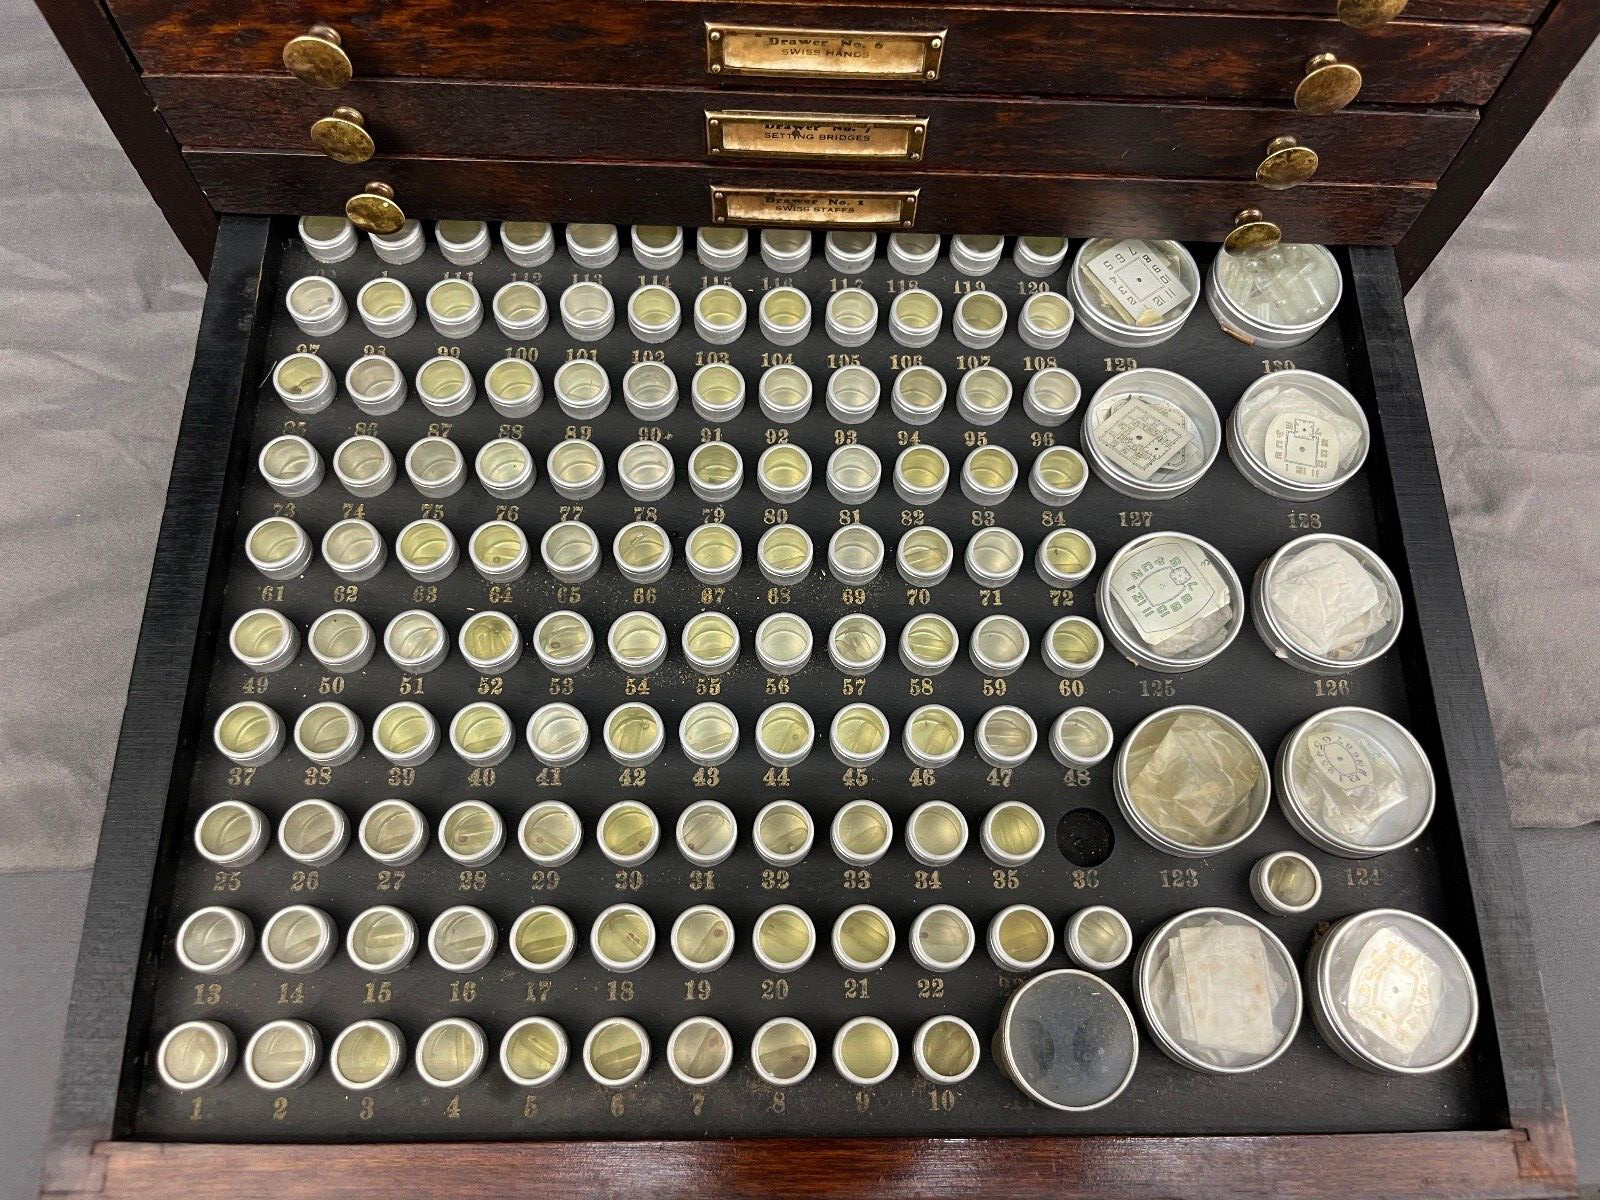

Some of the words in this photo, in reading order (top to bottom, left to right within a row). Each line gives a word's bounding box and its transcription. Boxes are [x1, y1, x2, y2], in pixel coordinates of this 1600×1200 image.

[769, 37, 828, 46] Drawer
[841, 40, 866, 48] No.
[826, 50, 869, 58] HANDS
[765, 197, 821, 205] Drawer
[953, 280, 986, 294] 119
[1018, 282, 1049, 294] 120
[505, 347, 538, 362] 100
[566, 349, 598, 361] 101
[632, 350, 665, 362] 102
[695, 352, 730, 366] 103
[761, 353, 795, 367] 104
[827, 354, 861, 368] 105
[890, 355, 923, 369] 106
[957, 356, 990, 370] 107
[1023, 357, 1057, 370] 108
[1104, 358, 1137, 372] 129
[428, 423, 452, 438] 87
[565, 426, 592, 440] 89
[638, 427, 661, 442] 90
[701, 428, 722, 443] 91
[765, 429, 789, 444] 92
[835, 430, 857, 445] 93
[897, 431, 921, 446] 94
[964, 432, 987, 447] 95
[1031, 432, 1055, 447] 96
[274, 503, 296, 517] 73
[342, 504, 365, 519] 74
[421, 505, 444, 520] 75
[496, 506, 519, 522] 76
[560, 506, 583, 522] 77
[634, 507, 657, 522] 78
[703, 508, 725, 524] 79
[763, 509, 788, 524] 80
[839, 509, 861, 525] 81
[901, 510, 924, 525] 82
[971, 511, 995, 526] 83
[1042, 511, 1065, 527] 84
[1118, 512, 1152, 526] 127
[262, 586, 285, 602] 61
[334, 586, 357, 602] 62
[633, 587, 656, 603] 66
[842, 589, 865, 604] 69
[907, 589, 931, 604] 70
[980, 590, 1003, 605] 71
[1050, 591, 1073, 606] 72
[242, 677, 269, 694] 49
[318, 677, 344, 695] 50
[400, 678, 425, 695] 51
[478, 678, 503, 695] 52
[550, 679, 574, 695] 53
[625, 679, 650, 695] 54
[696, 679, 721, 695] 55
[766, 679, 789, 695] 56
[842, 679, 866, 695] 57
[910, 679, 934, 695] 58
[982, 679, 1007, 696] 59
[1059, 680, 1084, 696] 60
[1140, 680, 1176, 697] 125
[228, 768, 255, 786] 37
[305, 768, 332, 786] 38
[388, 768, 415, 786] 39
[468, 768, 496, 786] 40
[535, 768, 561, 786] 41
[619, 768, 646, 786] 42
[693, 769, 719, 786] 43
[763, 769, 790, 786] 44
[842, 769, 868, 786] 45
[909, 769, 936, 786] 46
[987, 769, 1013, 787] 47
[1063, 769, 1090, 787] 48
[214, 872, 241, 891] 25
[292, 871, 318, 890] 26
[378, 871, 404, 890] 27
[532, 871, 560, 890] 29
[690, 871, 715, 889] 31
[762, 870, 791, 889] 32
[844, 871, 872, 889] 33
[915, 871, 942, 889] 34
[993, 870, 1020, 889] 35
[1161, 870, 1199, 888] 123
[194, 984, 222, 1004] 13
[277, 983, 304, 1003] 14
[364, 982, 392, 1003] 15
[449, 981, 476, 1001] 16
[525, 981, 552, 1001] 17
[607, 981, 634, 1000] 18
[685, 980, 711, 1000] 19
[761, 979, 789, 999] 20
[845, 979, 870, 998] 21
[918, 979, 944, 998] 22
[191, 1098, 202, 1119] 1
[274, 1098, 288, 1119] 2
[360, 1098, 374, 1120] 3
[444, 1096, 461, 1118] 4
[773, 1093, 785, 1113] 8
[856, 1092, 869, 1112] 9
[928, 1091, 955, 1112] 10
